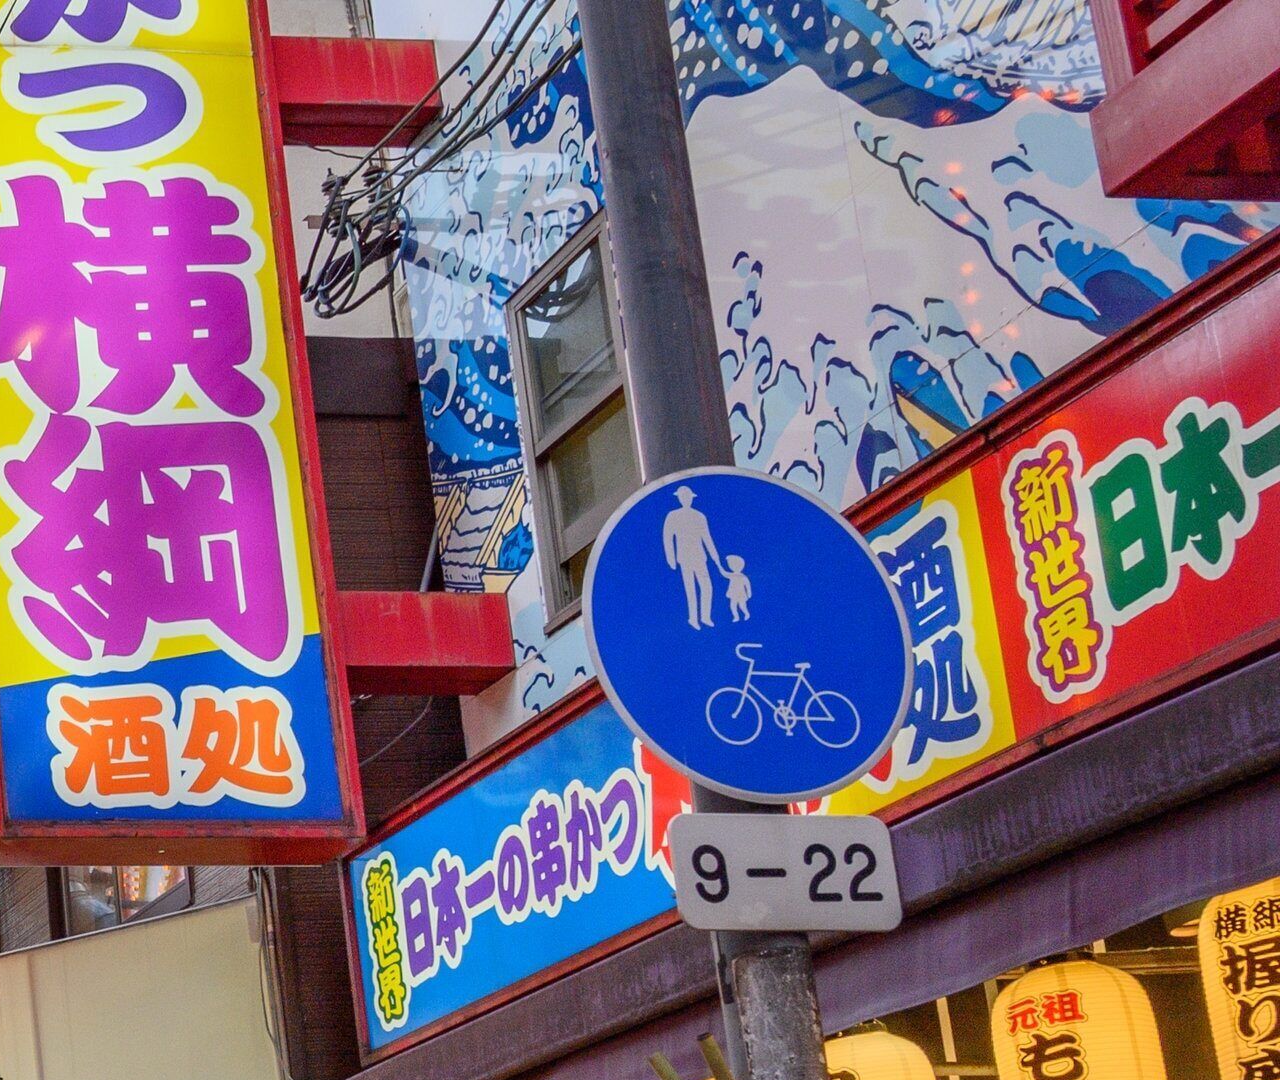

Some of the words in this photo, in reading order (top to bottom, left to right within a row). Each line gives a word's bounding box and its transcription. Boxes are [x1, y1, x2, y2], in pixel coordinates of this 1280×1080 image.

[886, 519, 985, 761] 酒処
[1015, 448, 1101, 691] 新世界
[59, 693, 295, 799] 酒処
[366, 860, 404, 1021] 新世界
[403, 782, 640, 977] 日本一の串かつ
[1007, 991, 1085, 1035] 元祖
